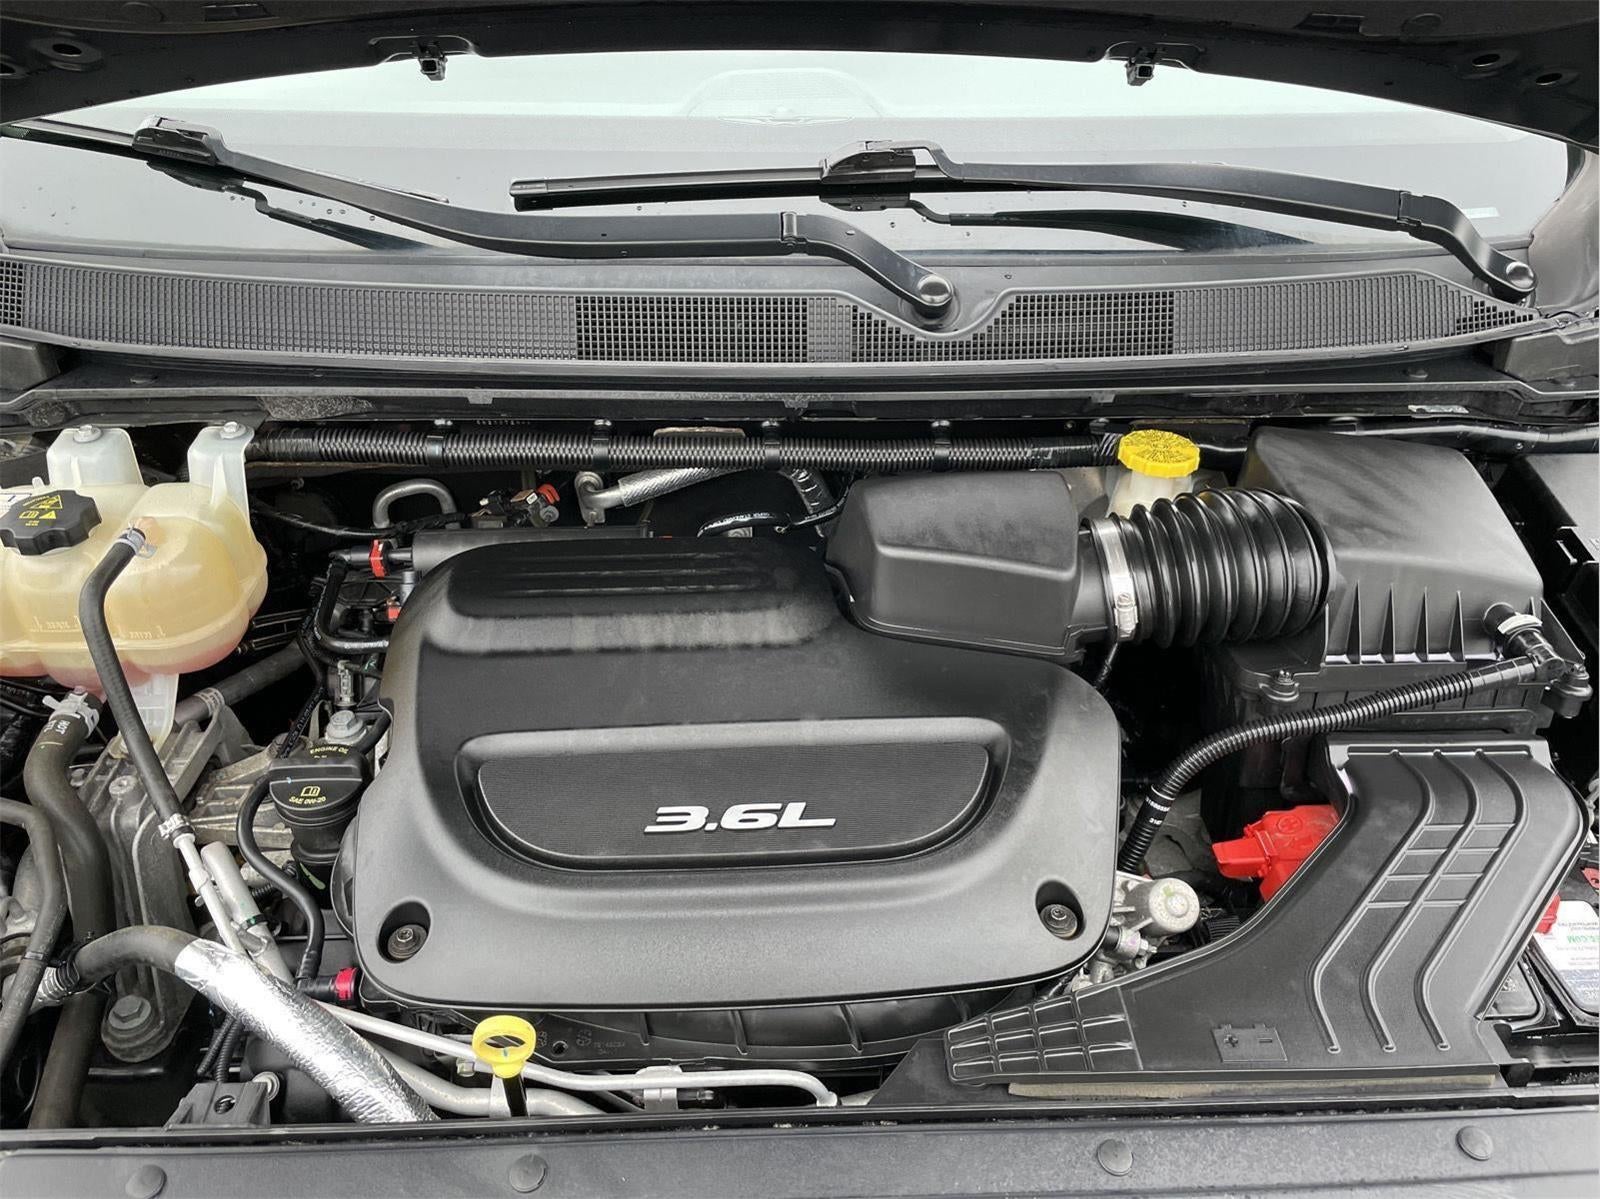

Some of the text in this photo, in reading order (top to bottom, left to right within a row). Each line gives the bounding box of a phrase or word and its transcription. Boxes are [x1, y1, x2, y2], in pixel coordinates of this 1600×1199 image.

[310, 746, 338, 755] ENGINE
[288, 796, 304, 805] SAE
[643, 802, 836, 834] 3.6L
